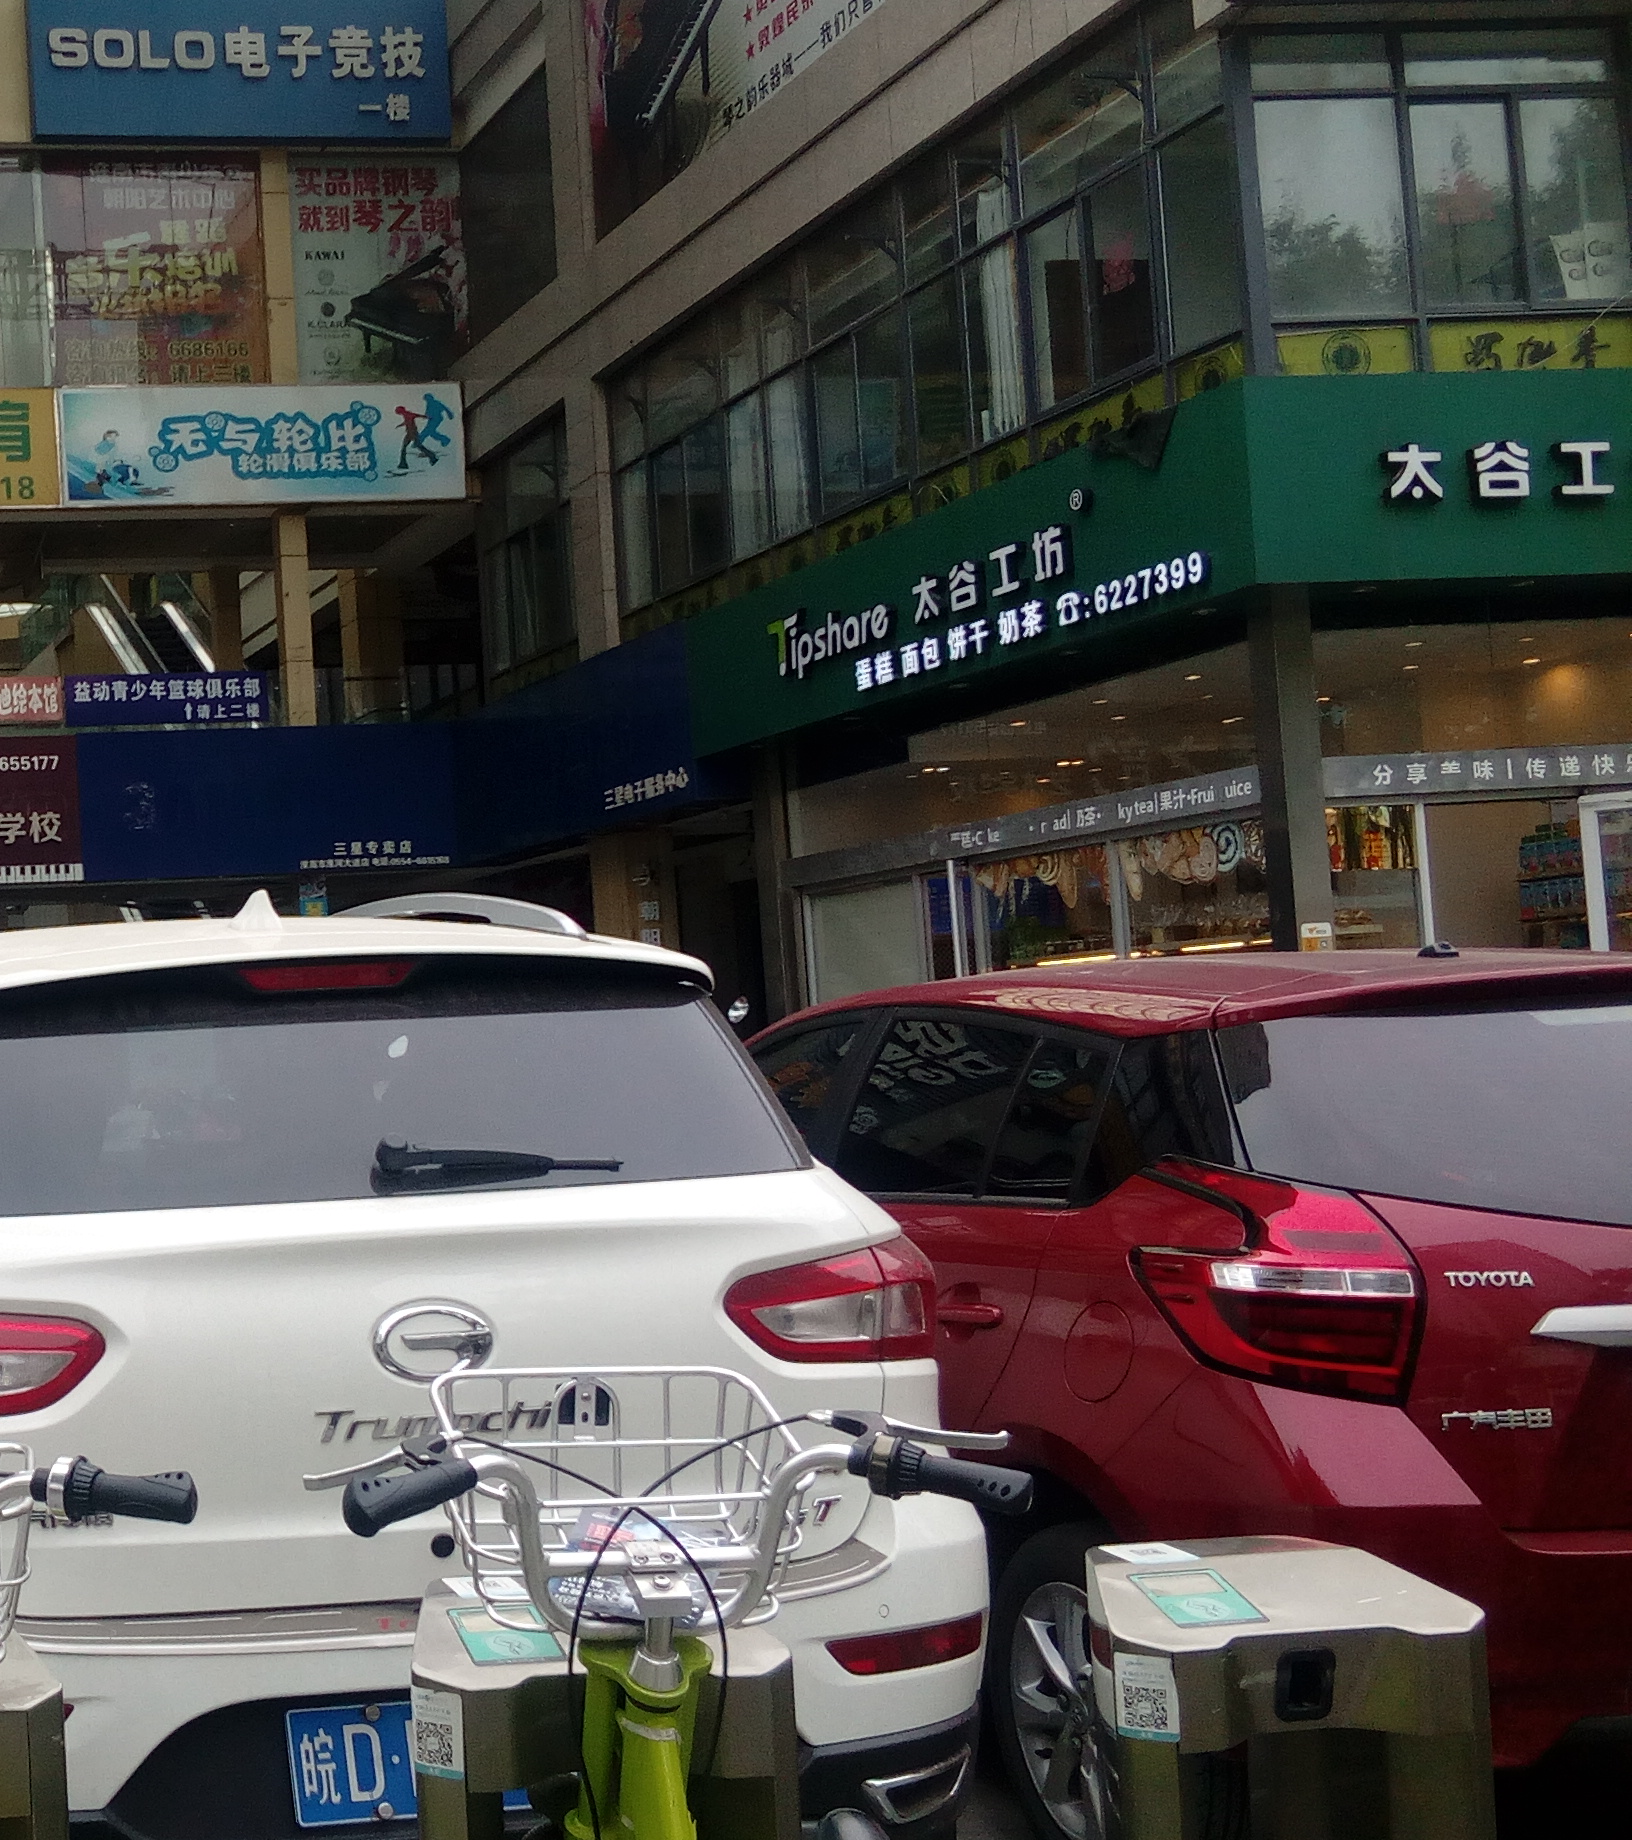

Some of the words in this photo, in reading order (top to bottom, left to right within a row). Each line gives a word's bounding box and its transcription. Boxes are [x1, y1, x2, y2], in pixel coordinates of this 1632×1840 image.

[48, 25, 426, 81] SOLO电子竞技
[358, 92, 411, 122] 一楼
[304, 250, 346, 261] KAWAI
[1388, 442, 1616, 500] 太谷工
[769, 612, 889, 679] Tipshare
[911, 524, 1066, 625] 太谷工坊
[854, 651, 894, 693] 蛋糕
[900, 636, 941, 677] 面包
[947, 619, 989, 662] 饼干
[997, 600, 1044, 647] 奶茶
[74, 677, 262, 703] 益动青少年篮球俱乐部
[1444, 1271, 1535, 1288] TOYOTA
[1441, 1408, 1553, 1431] 广汽丰田
[300, 1720, 416, 1806] 皖D·
